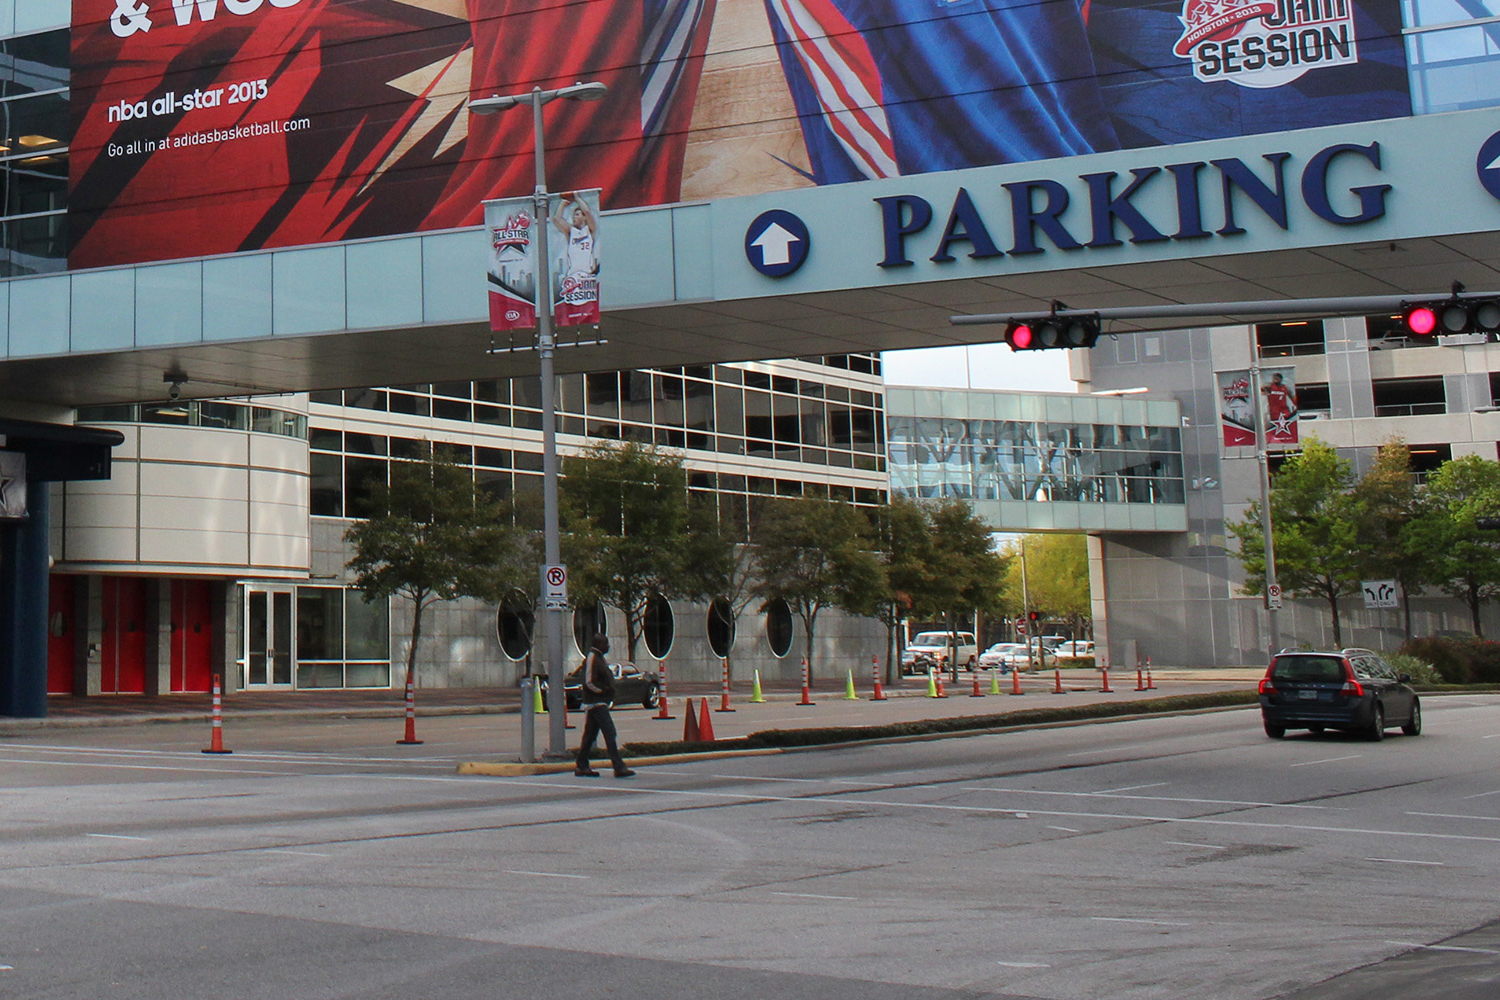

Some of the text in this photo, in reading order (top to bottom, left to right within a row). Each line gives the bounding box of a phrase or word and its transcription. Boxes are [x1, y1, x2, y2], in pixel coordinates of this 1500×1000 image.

[1187, 6, 1262, 43] HOUSTON 2013
[1197, 24, 1350, 76] SESSION
[108, 79, 268, 123] nba all-star 2013
[108, 117, 311, 157] Go all in at adidasbasketball.com
[873, 141, 1393, 268] PARKING
